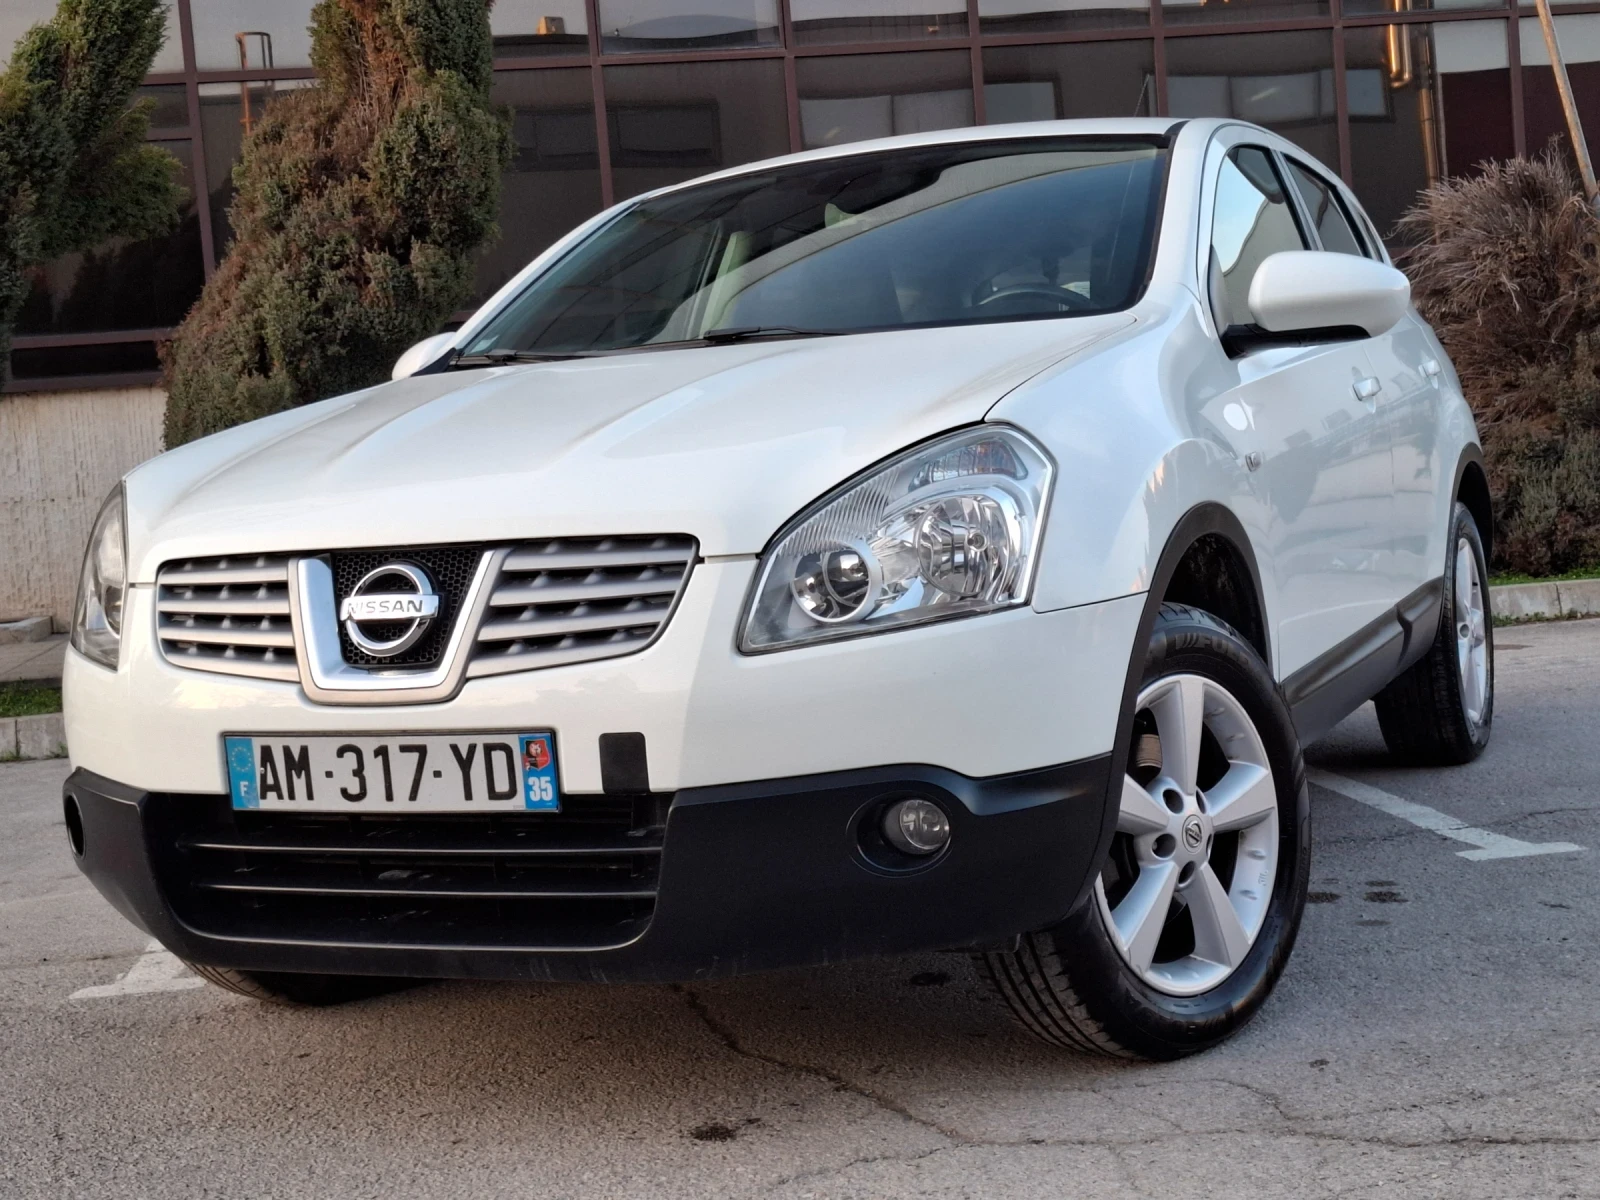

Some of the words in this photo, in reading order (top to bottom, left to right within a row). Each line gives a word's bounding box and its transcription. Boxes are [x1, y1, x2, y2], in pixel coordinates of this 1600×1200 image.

[346, 599, 423, 615] NISSAN
[240, 781, 249, 797] F
[528, 776, 553, 802] 35
